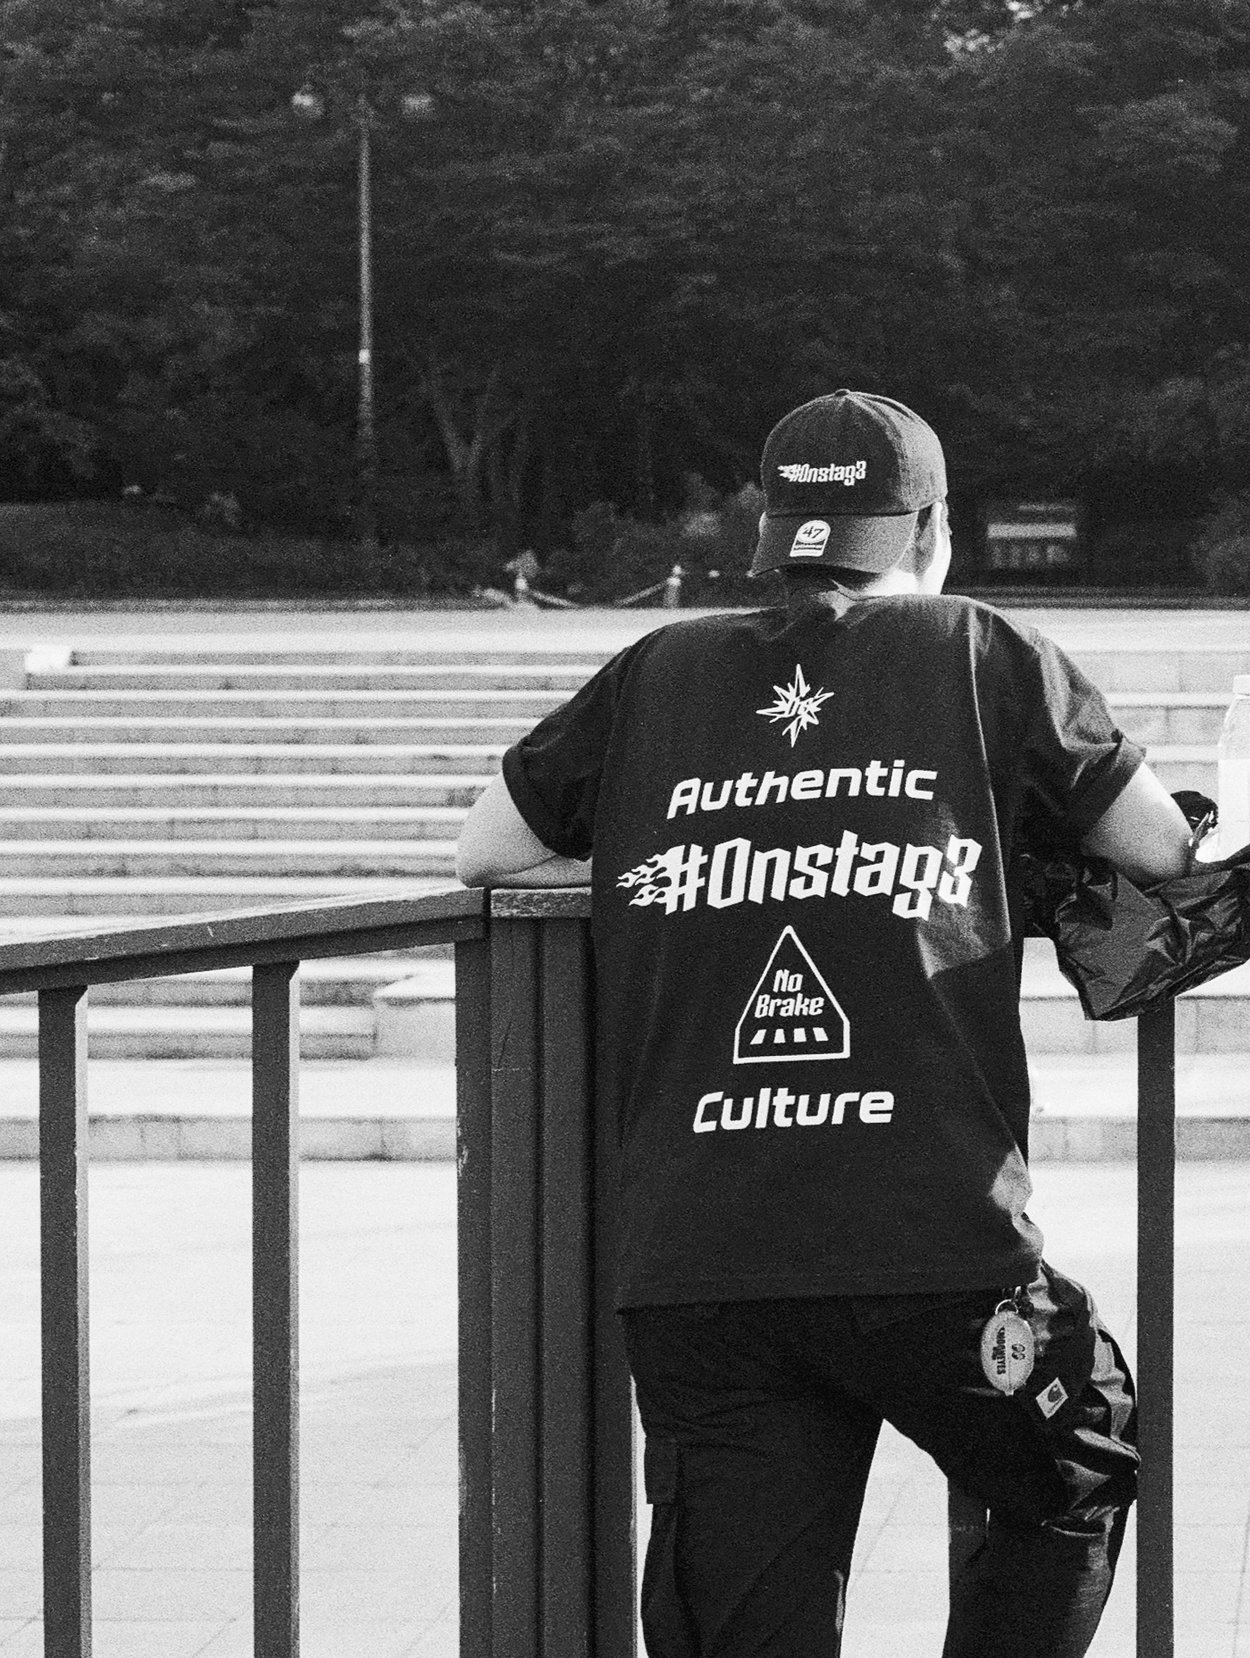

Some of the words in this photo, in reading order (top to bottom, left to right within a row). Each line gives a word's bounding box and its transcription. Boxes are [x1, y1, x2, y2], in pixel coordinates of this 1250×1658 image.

[666, 759, 938, 820] Authentic
[772, 969, 803, 993] No
[754, 993, 825, 1018] Brake
[692, 1087, 895, 1134] Culture
